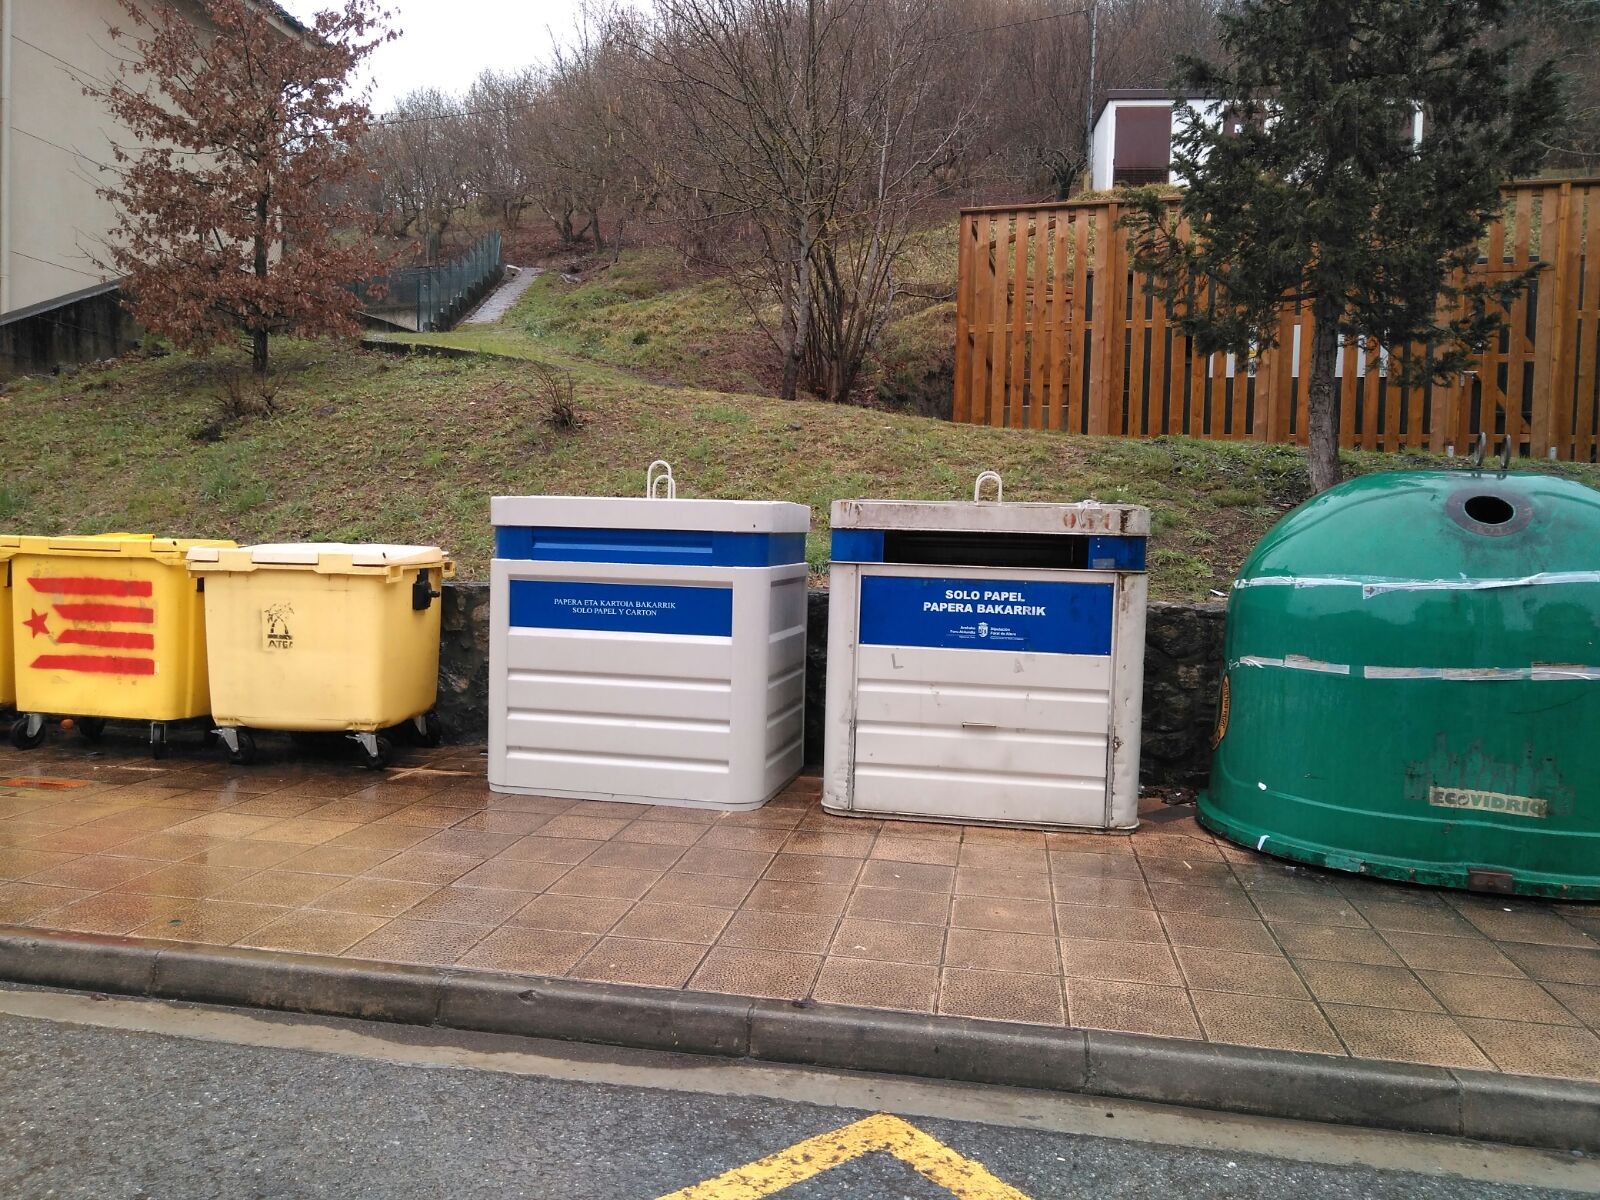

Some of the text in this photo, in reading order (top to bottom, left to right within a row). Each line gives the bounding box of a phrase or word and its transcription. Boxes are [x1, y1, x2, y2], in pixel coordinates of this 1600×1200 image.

[945, 589, 1025, 602] SOLO PAPEL
[554, 598, 582, 606] PAPERA
[599, 600, 634, 608] KARTOIA
[635, 601, 676, 609] BAKARRIK
[923, 601, 1047, 616] PAPERA BAKARRIK
[625, 608, 657, 616] CARTON
[1432, 791, 1547, 817] ECOVIDRIO
